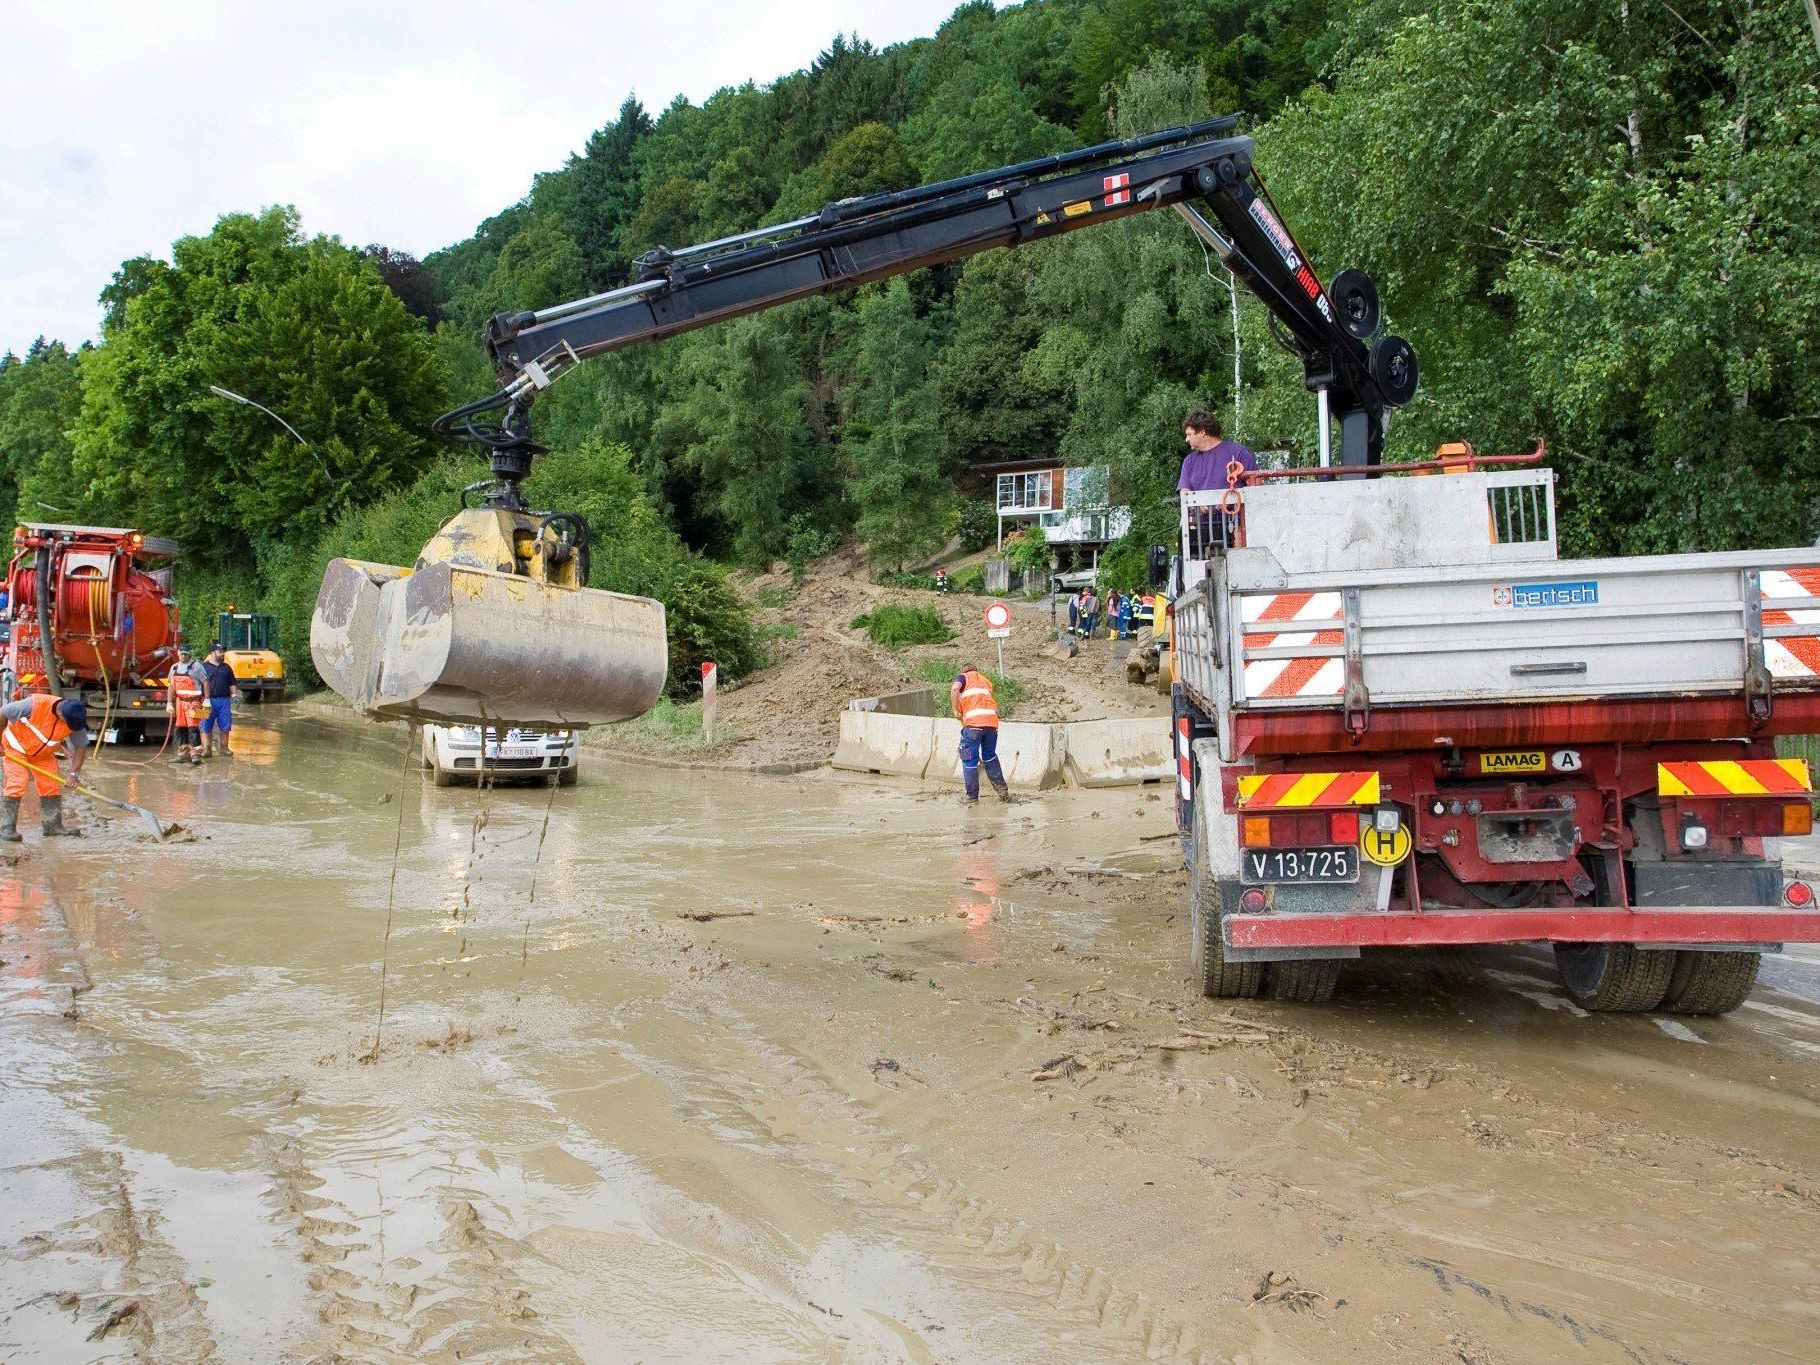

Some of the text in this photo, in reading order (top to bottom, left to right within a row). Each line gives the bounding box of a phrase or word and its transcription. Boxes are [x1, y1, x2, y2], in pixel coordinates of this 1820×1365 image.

[1295, 265, 1320, 299] HIAB
[1513, 584, 1595, 606] bertsch
[1486, 753, 1541, 767] LAMAG
[1561, 752, 1575, 767] A
[1377, 831, 1395, 855] H
[1252, 853, 1267, 878] V
